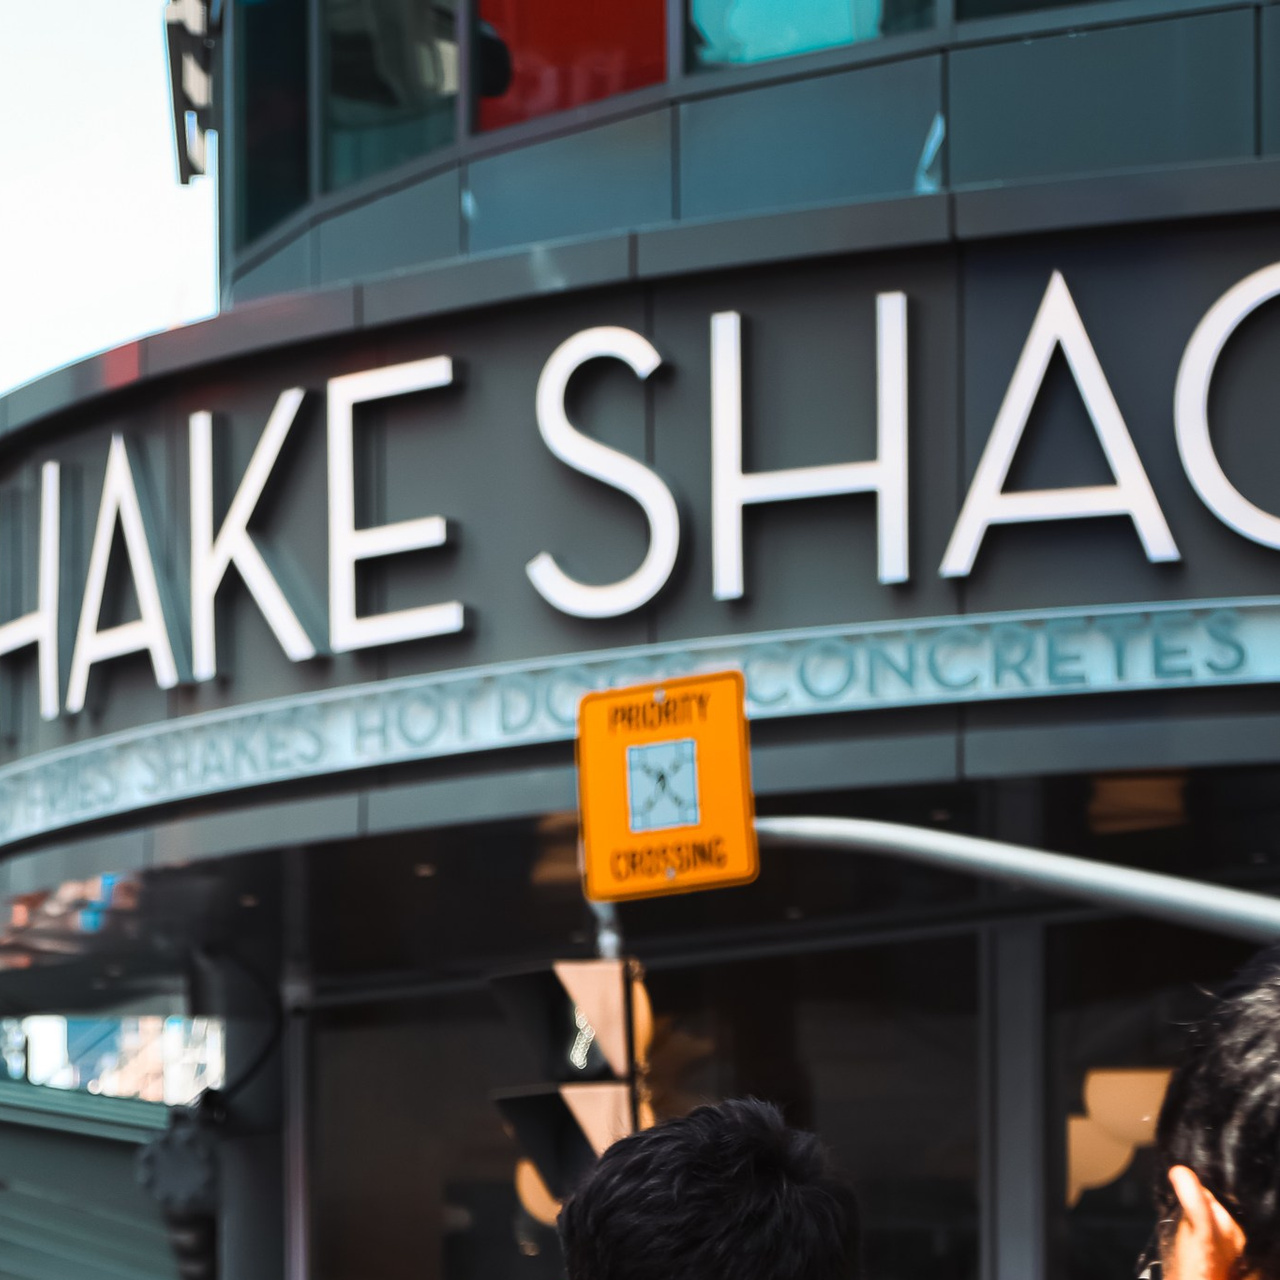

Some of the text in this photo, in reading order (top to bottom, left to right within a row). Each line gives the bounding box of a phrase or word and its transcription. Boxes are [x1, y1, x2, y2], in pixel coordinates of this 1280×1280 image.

[140, 706, 325, 793] SHAKES
[354, 675, 488, 756] HOT
[740, 606, 1247, 708] CONCRETES
[609, 692, 710, 733] PRIORITY
[610, 837, 728, 880] CROSSING
